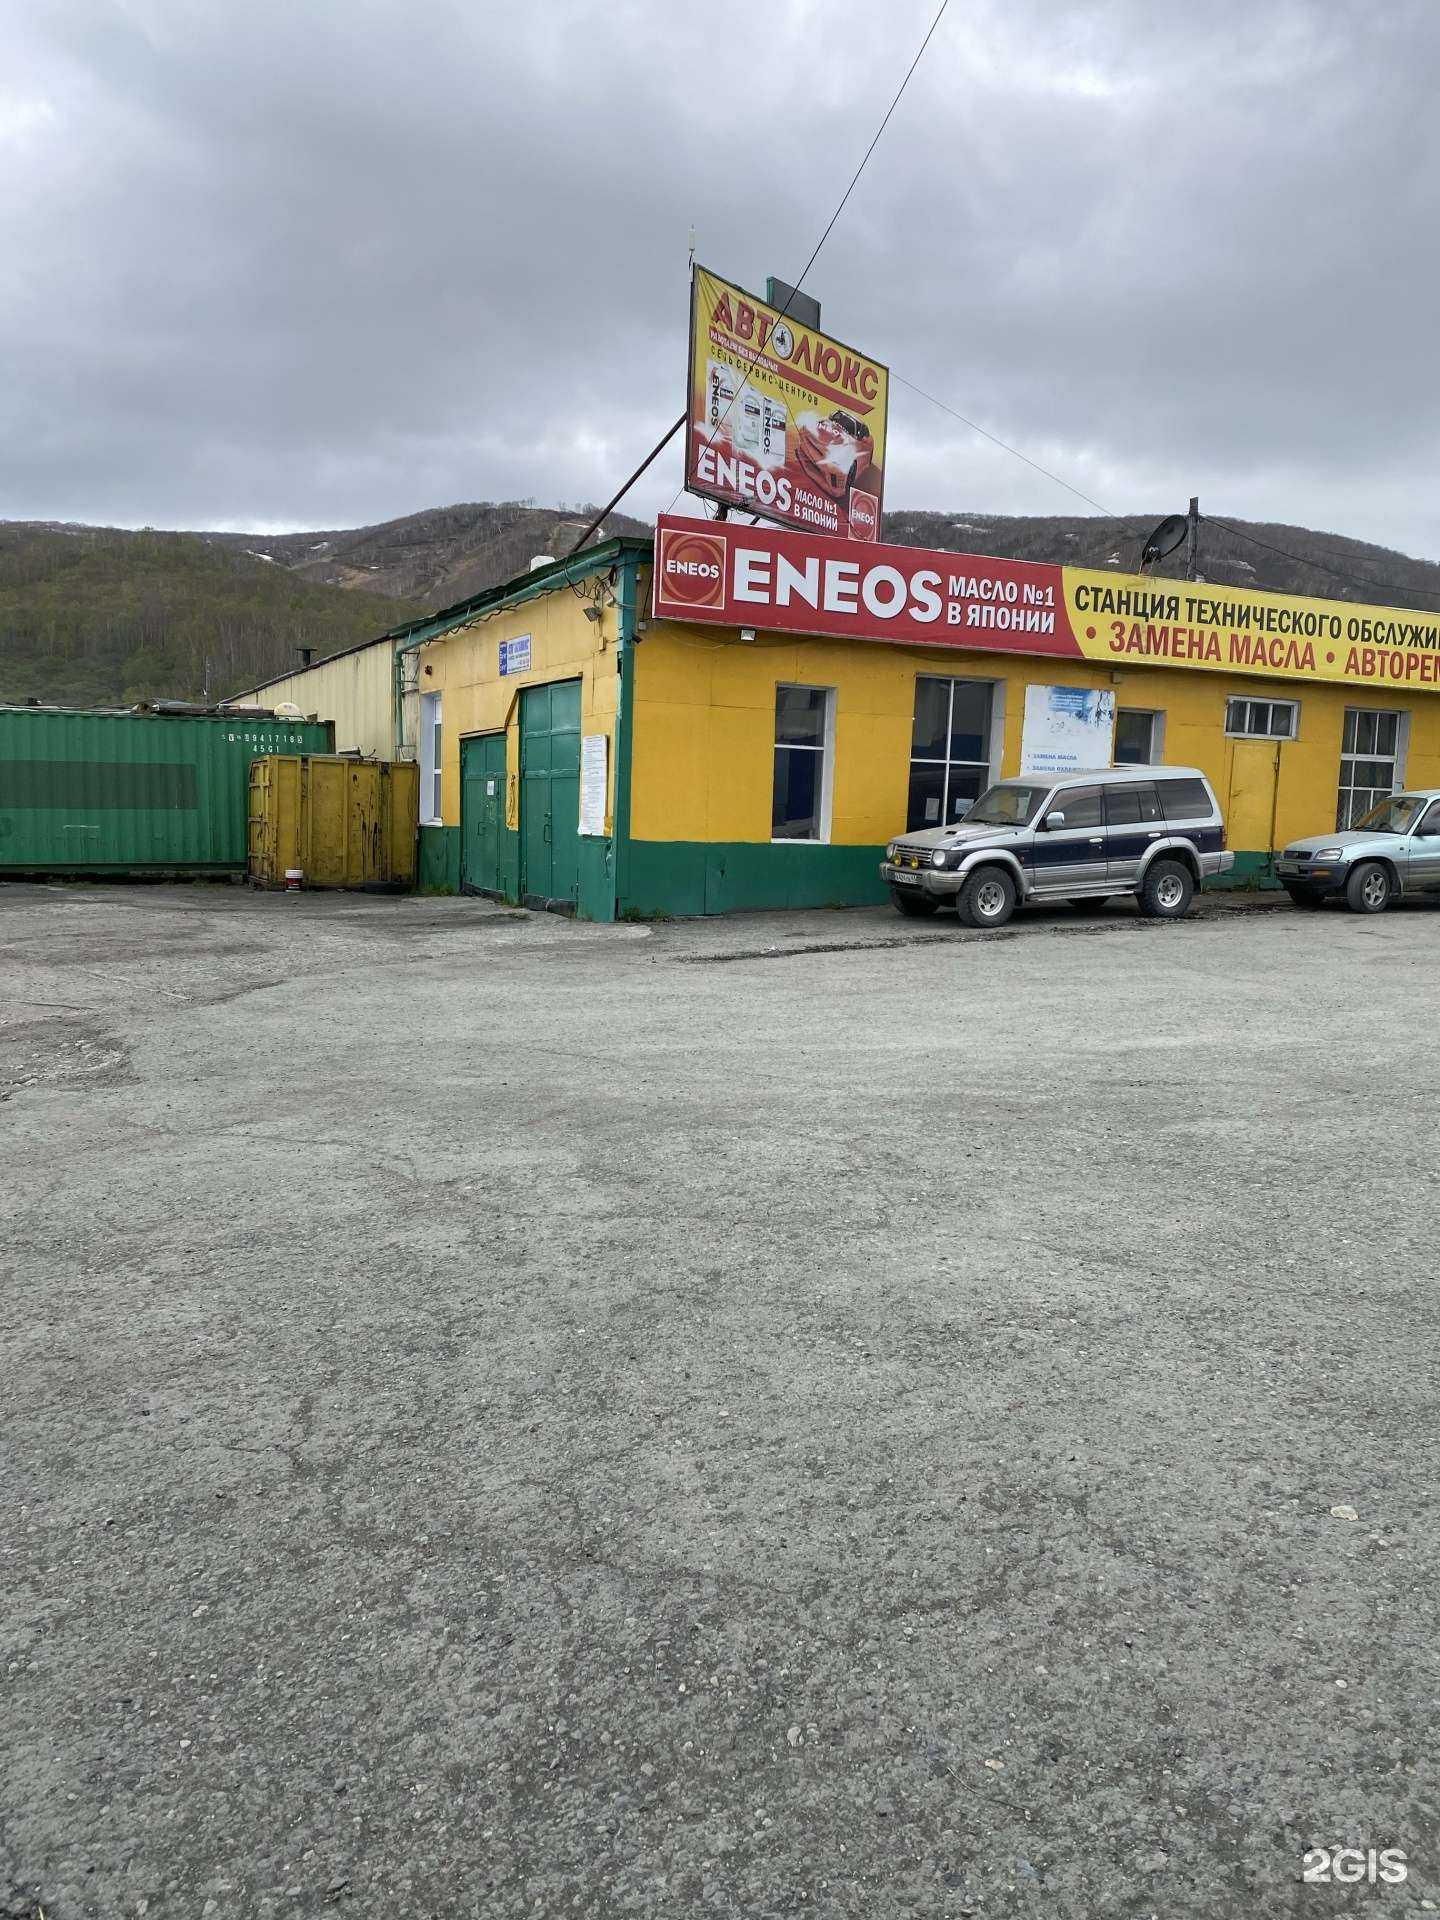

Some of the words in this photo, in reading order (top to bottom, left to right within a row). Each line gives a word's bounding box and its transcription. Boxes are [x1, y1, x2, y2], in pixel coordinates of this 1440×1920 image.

[764, 406, 772, 455] ENEOS
[697, 444, 792, 512] ENEOS
[795, 487, 823, 510] МАСЛО
[794, 504, 801, 518] В
[802, 508, 838, 532] ЯПОНИИ
[852, 508, 875, 526] ENEOS
[666, 559, 719, 579] ENEOS
[733, 548, 943, 623] ENEOS
[948, 575, 1018, 603] МАСЛО
[1023, 583, 1055, 607] №1
[947, 602, 961, 625] В
[966, 604, 1055, 634] ЯПОНИИ
[1074, 585, 1179, 622] СТАНЦИЯ
[1185, 597, 1342, 640] ТЕХНИЧЕСКОГО
[1347, 617, 1440, 650] ОБСЛУЖИ
[1109, 621, 1222, 662] ЗАМЕНА
[1229, 633, 1316, 671] МАСЛА
